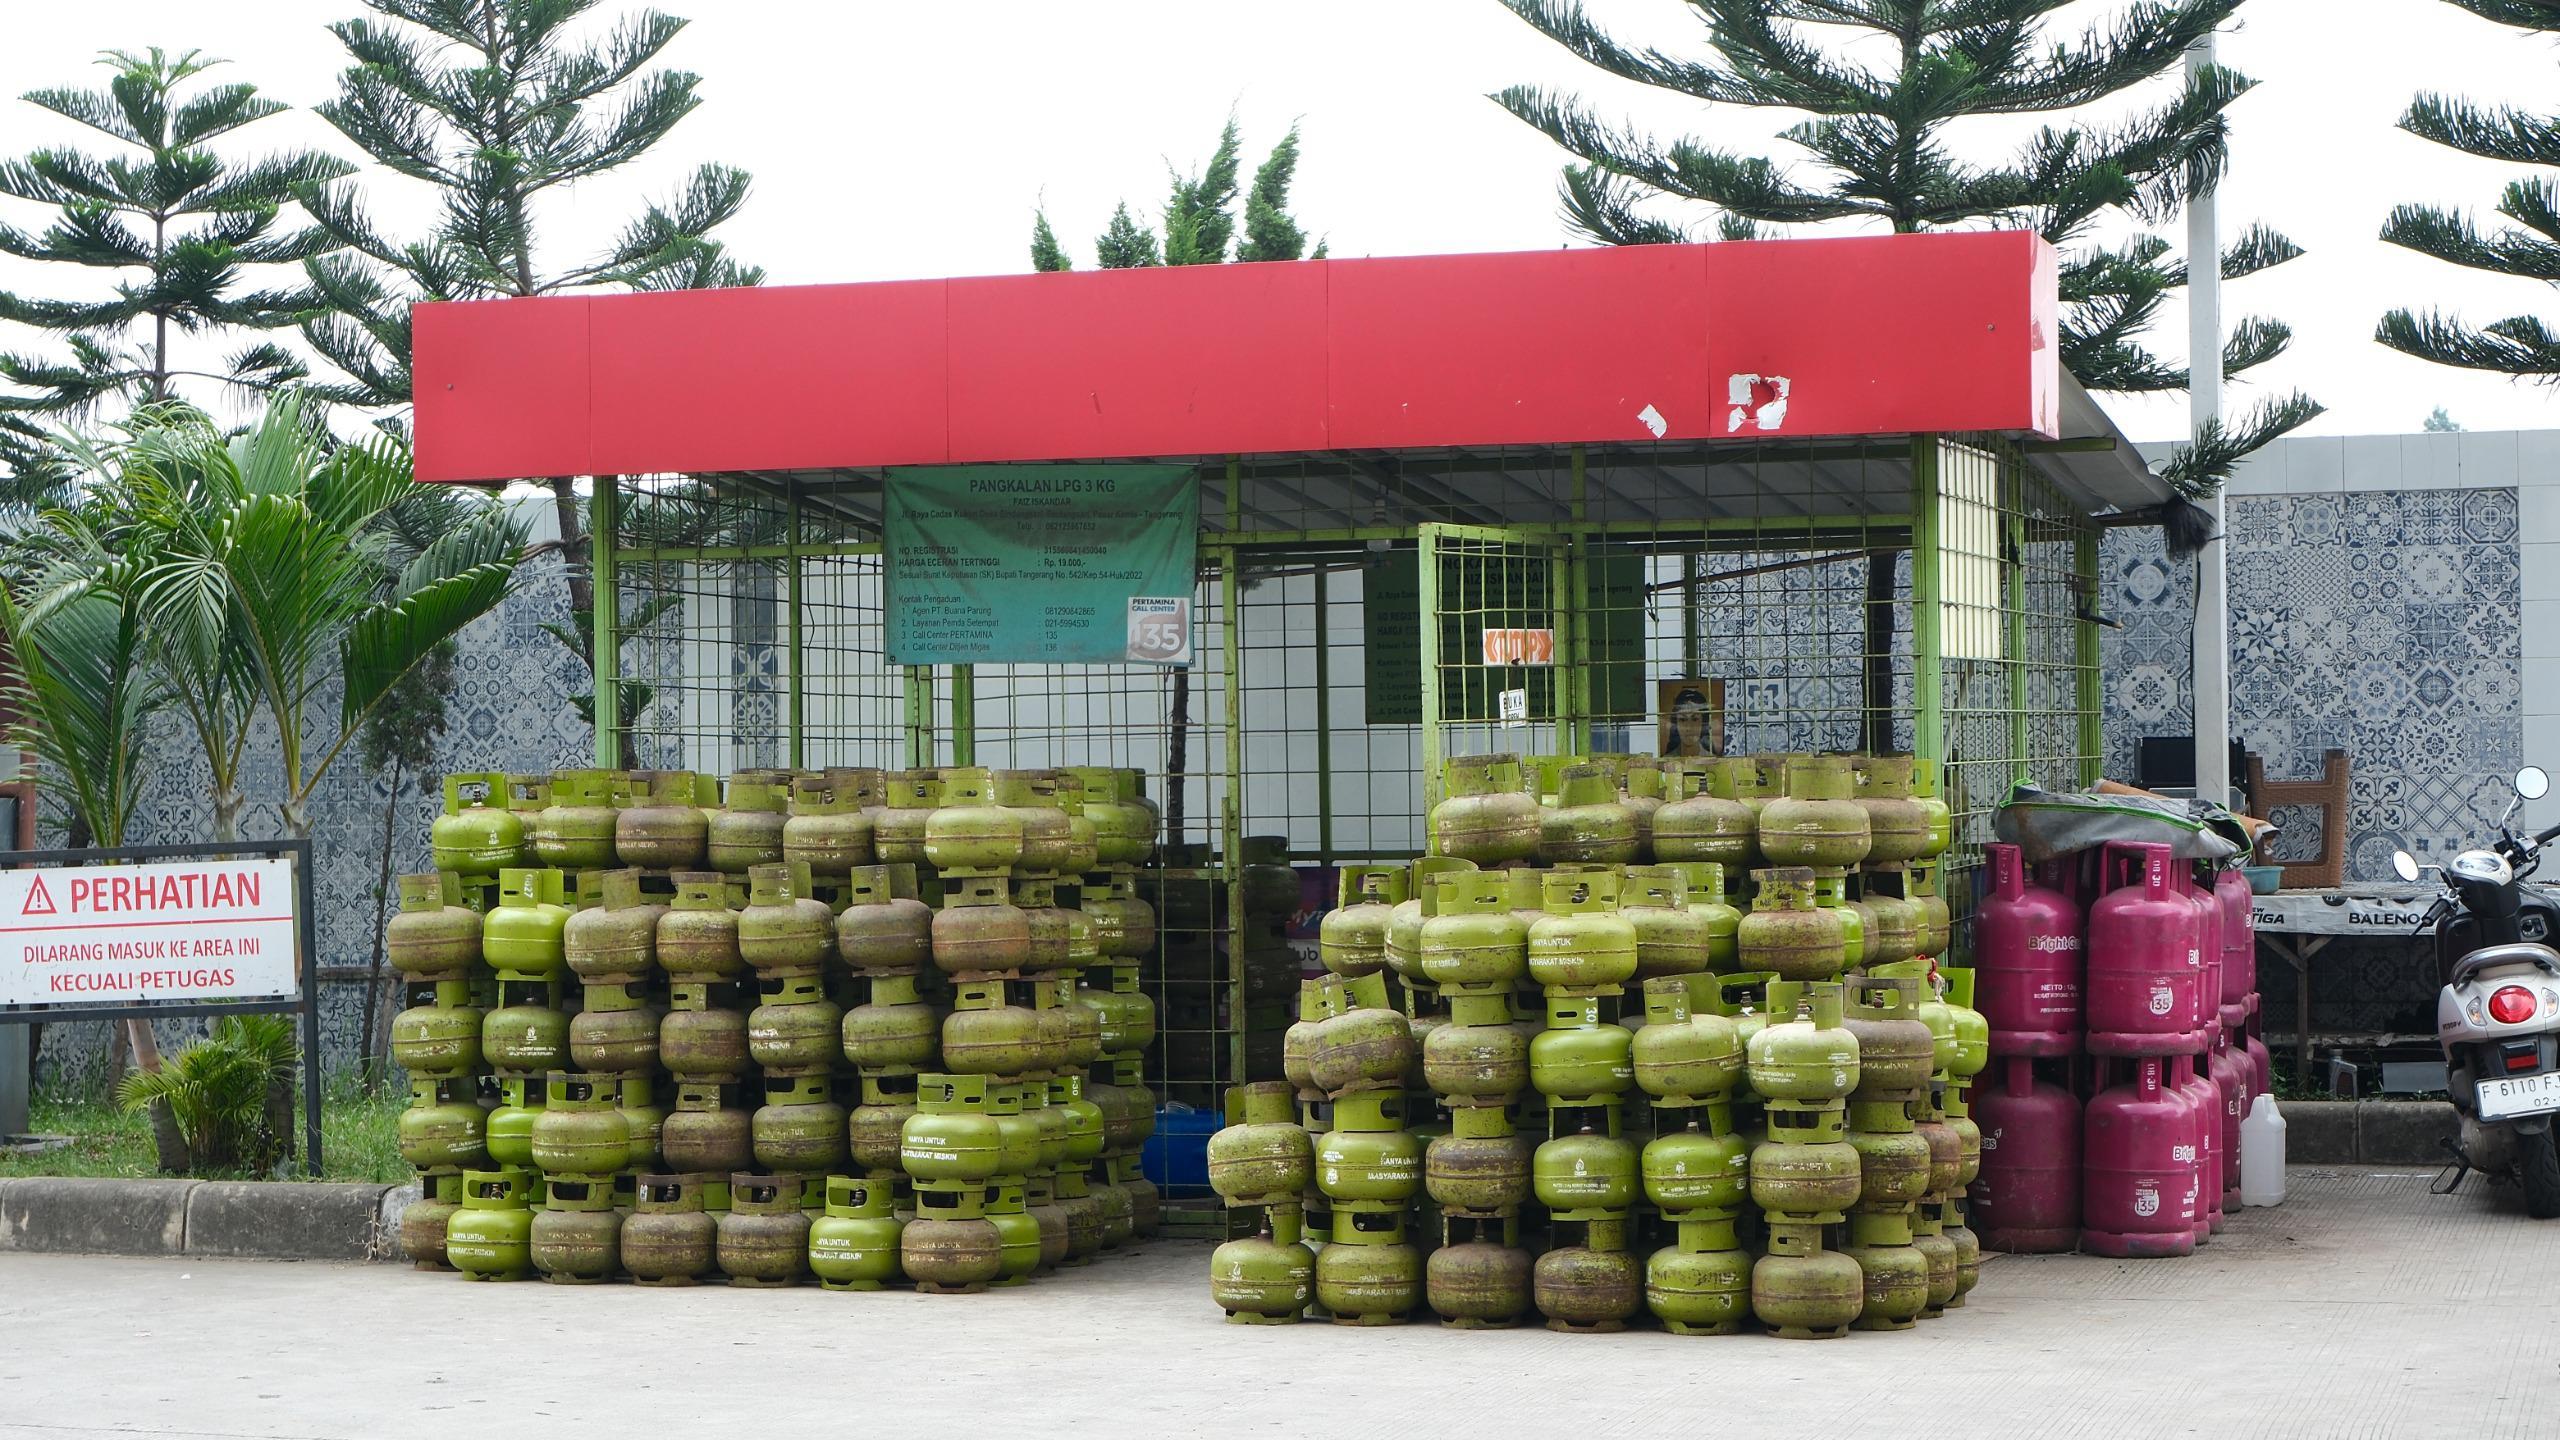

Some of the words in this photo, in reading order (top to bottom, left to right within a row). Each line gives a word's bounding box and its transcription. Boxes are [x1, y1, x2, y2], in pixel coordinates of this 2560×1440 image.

[970, 480, 1051, 492] PANGKALAN
[1055, 480, 1081, 492] LPG
[1085, 480, 1093, 492] 3
[1096, 480, 1116, 492] KG
[914, 546, 959, 555] REGISTRASI
[899, 558, 926, 567] HARGA
[928, 558, 959, 567] ECERAN
[960, 558, 1000, 567] TERTINGGI
[1044, 558, 1056, 568] Rp.
[1019, 570, 1053, 580] Tangerang
[912, 630, 925, 639] Call
[926, 630, 949, 639] Center
[950, 630, 993, 639] PERTAMINA
[1503, 695, 1523, 710] BUKA
[71, 872, 261, 912] PERHATIAN
[2252, 913, 2285, 924] TIGA
[2349, 912, 2421, 925] BALENO
[24, 944, 103, 963] DILARANG
[108, 941, 165, 961] MASUK
[170, 940, 188, 957] KE
[193, 938, 234, 957] AREA
[239, 938, 260, 955] INI
[2028, 936, 2068, 953] Bright
[50, 972, 133, 992] KECUALI
[140, 969, 235, 989] PETUGAS
[2151, 998, 2170, 1010] 135
[2482, 1084, 2491, 1099] F
[2500, 1078, 2537, 1097] 6110
[925, 1137, 946, 1145] UNTUK
[934, 1152, 958, 1161] MISKIN
[2136, 1200, 2155, 1212] 135
[829, 1238, 851, 1246] UNTUK
